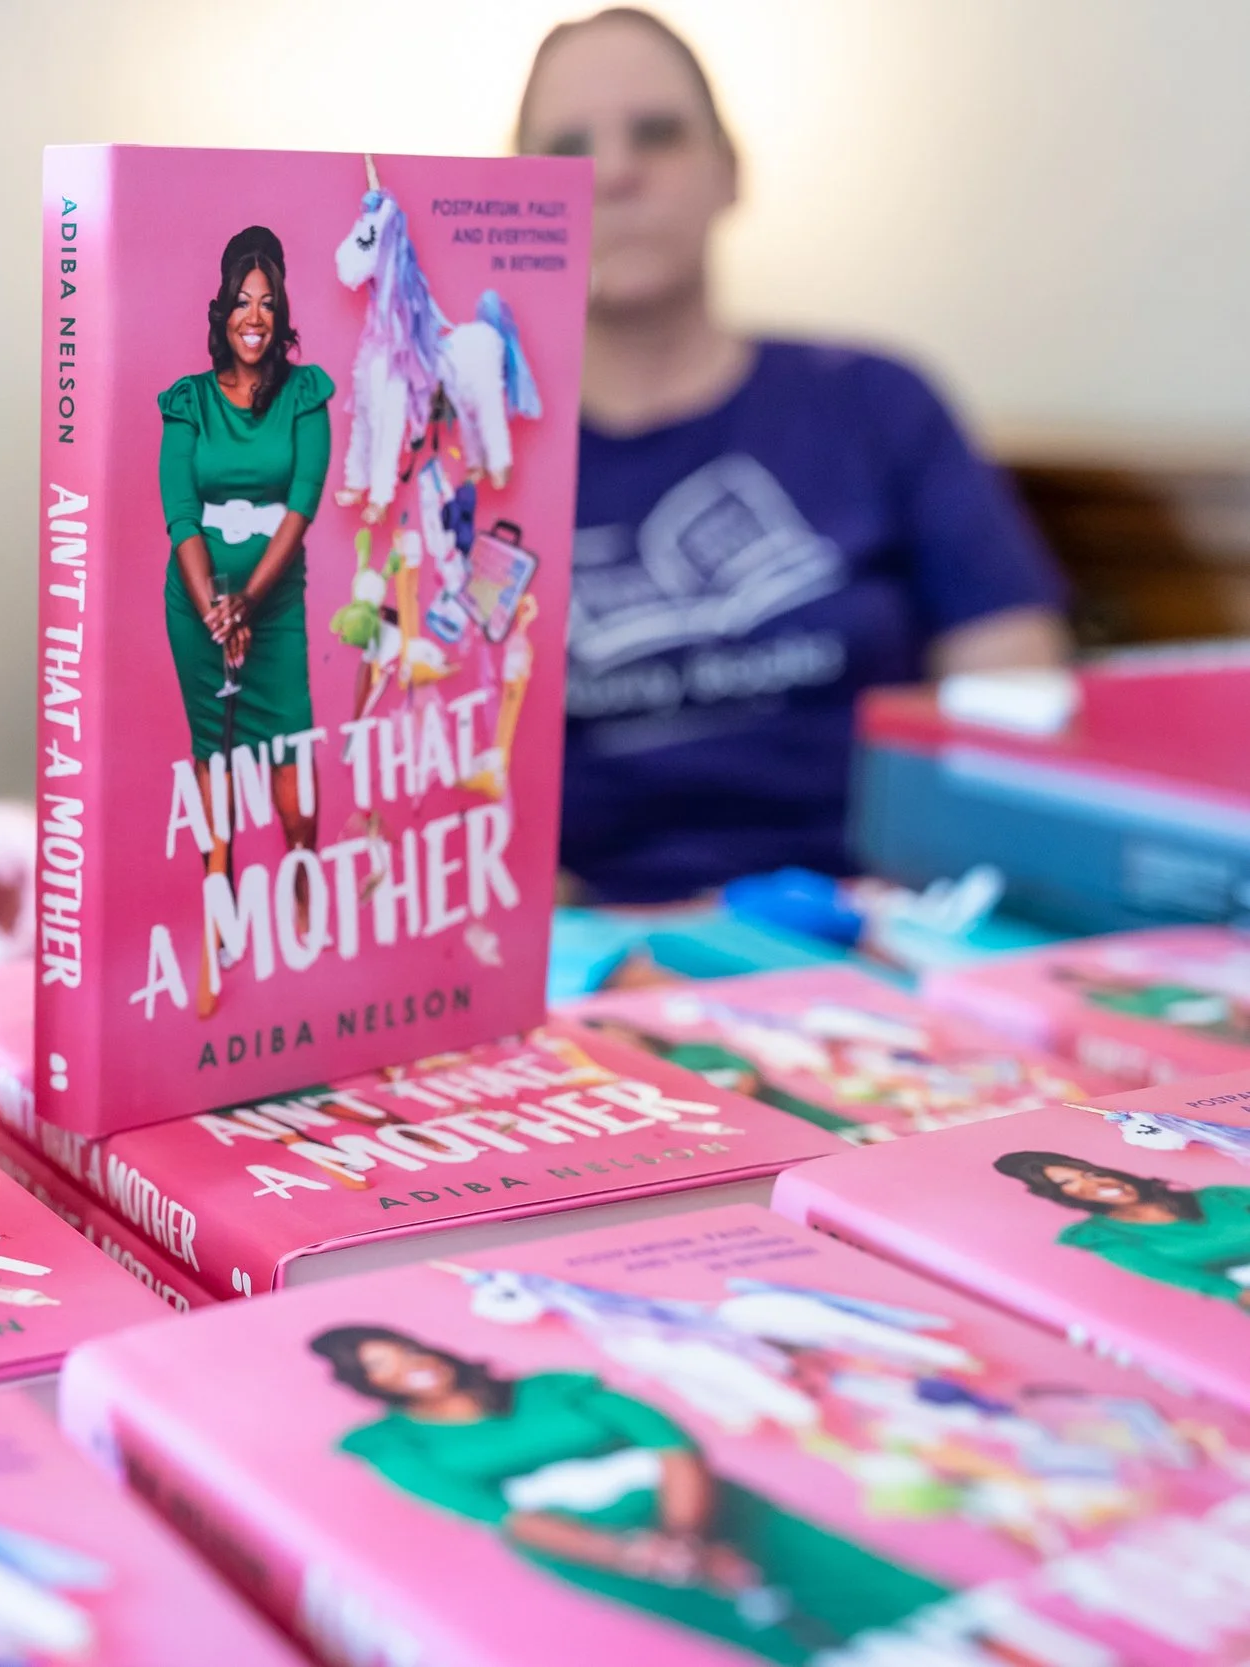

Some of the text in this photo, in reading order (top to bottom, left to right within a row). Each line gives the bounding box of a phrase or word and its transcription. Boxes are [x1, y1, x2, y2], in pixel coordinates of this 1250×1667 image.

[58, 195, 77, 444] ADIBA NELSON
[42, 483, 89, 990] AIN'T THAT A MOTHER
[166, 688, 495, 860] AIN'T THAT
[129, 804, 519, 1020] A MOTHER
[197, 986, 472, 1071] ADIBA NELSON
[193, 1053, 558, 1147] AIN'T THAT
[245, 1080, 720, 1200] A MOTHER
[1185, 1091, 1250, 1109] POSTPA
[106, 1154, 201, 1272] MOTHER
[378, 1142, 730, 1210] ADIBA NELSON
